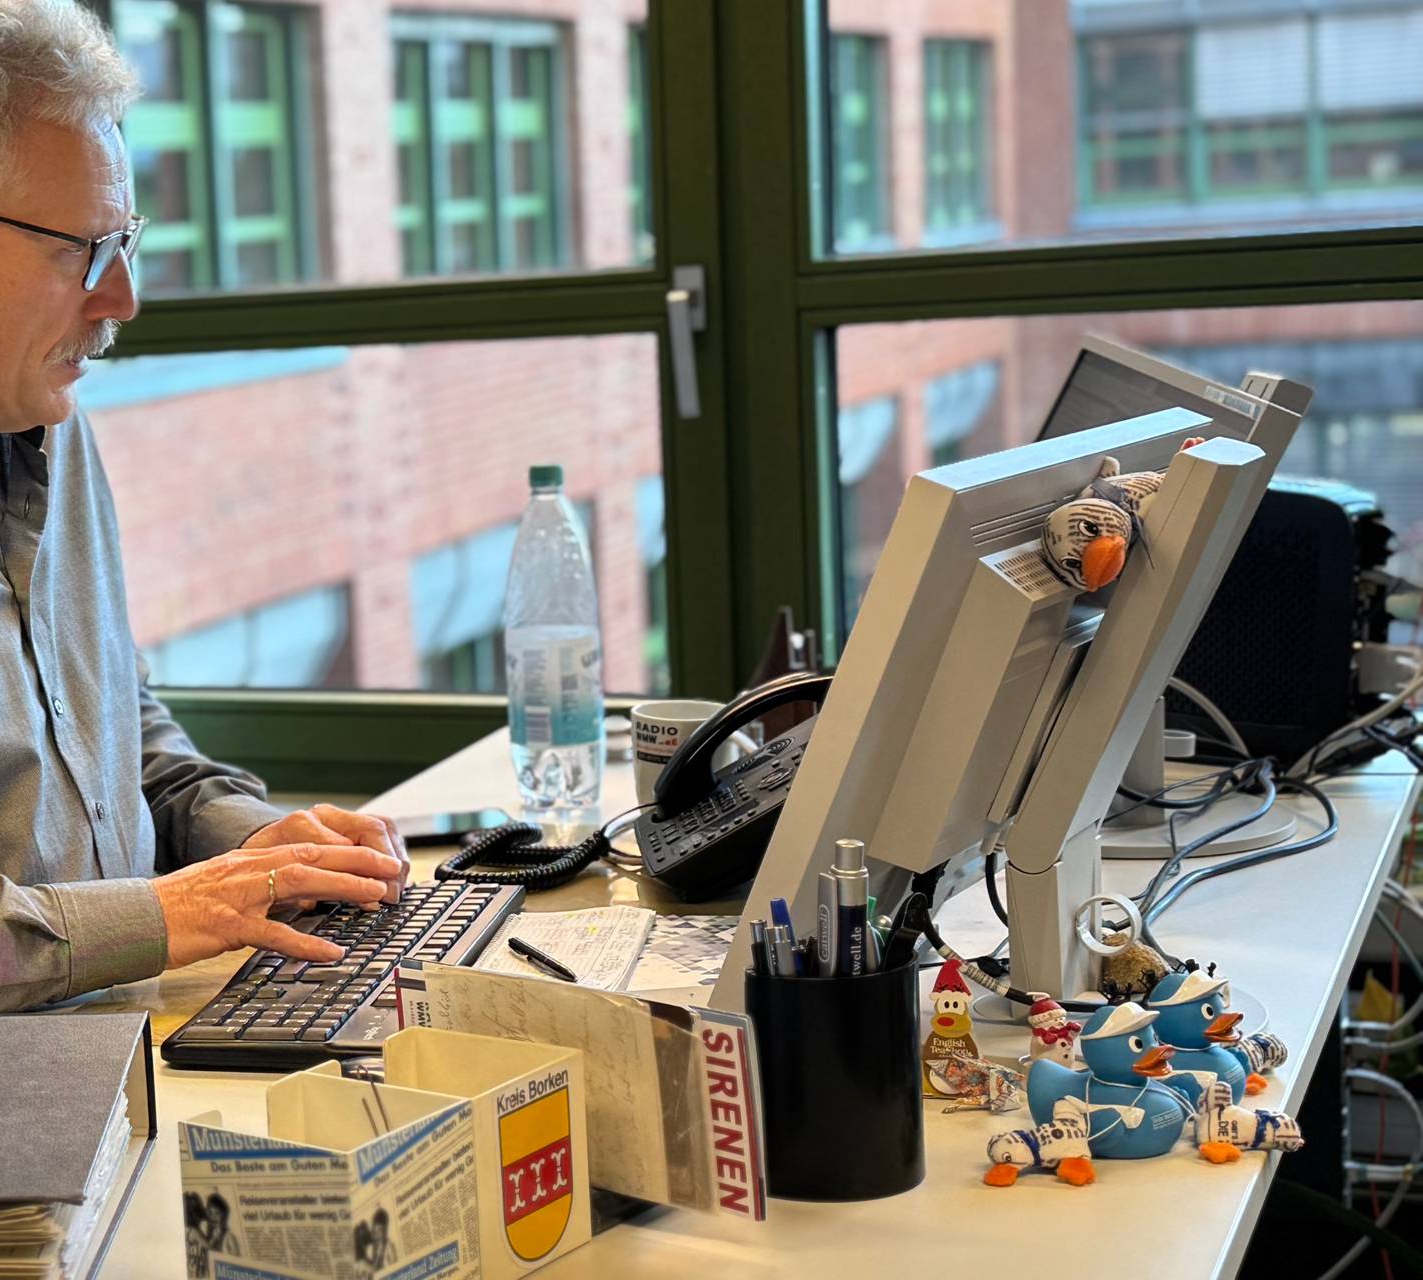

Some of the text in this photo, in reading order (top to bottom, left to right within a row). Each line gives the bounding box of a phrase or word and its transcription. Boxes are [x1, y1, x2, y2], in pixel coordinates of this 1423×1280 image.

[636, 722, 678, 736] RADIO
[933, 1037, 966, 1049] English
[497, 1069, 568, 1115] Kreis Borken
[431, 1119, 457, 1143] Guten
[703, 1029, 749, 1214] SIRENEN
[1218, 1121, 1229, 1137] DIE
[211, 1161, 232, 1173] Das
[235, 1160, 266, 1173] Beste
[269, 1161, 288, 1172] am
[291, 1158, 326, 1171] Guten
[428, 1246, 457, 1271] Zeitung
